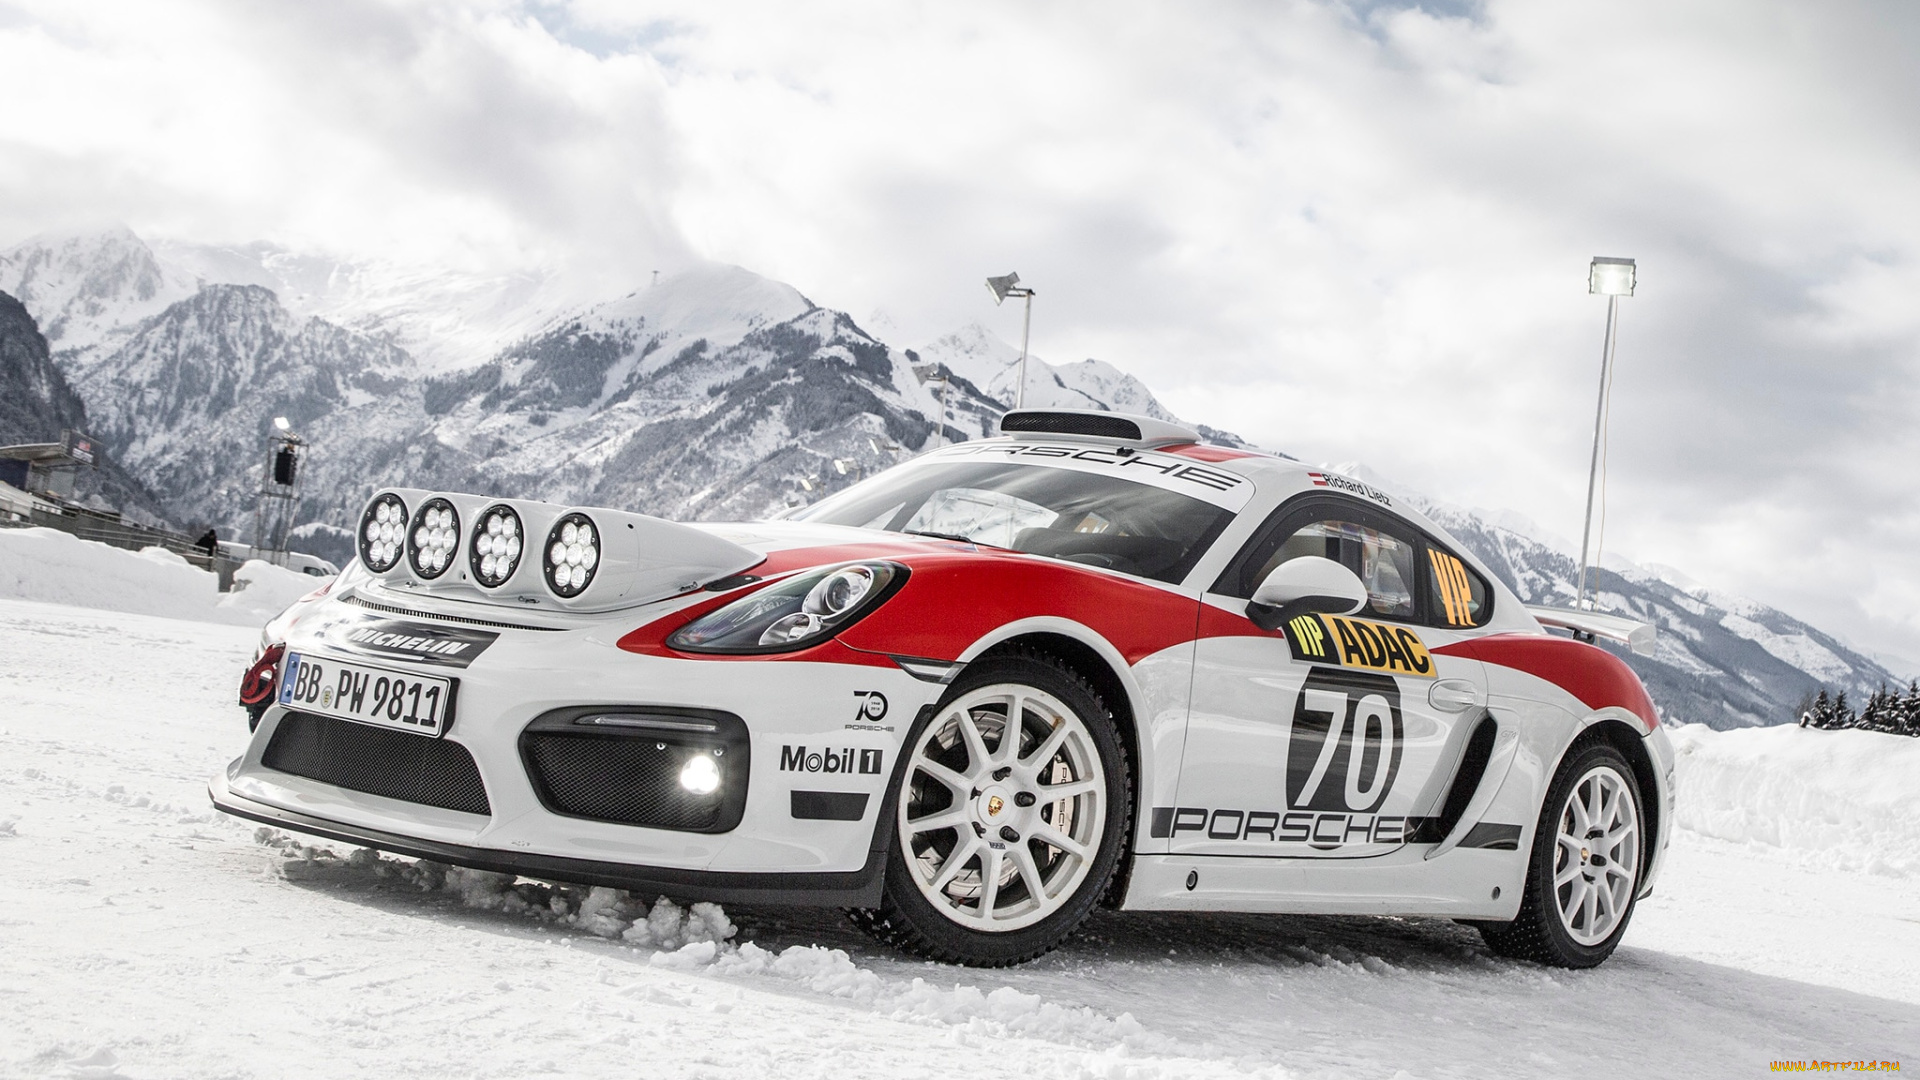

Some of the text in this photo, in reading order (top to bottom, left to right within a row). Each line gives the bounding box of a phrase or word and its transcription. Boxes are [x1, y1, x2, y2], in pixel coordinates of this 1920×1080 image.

[938, 446, 1242, 491] ORSCHE
[1322, 473, 1392, 507] Richard Lietz
[1427, 548, 1478, 626] VIP
[348, 628, 471, 655] MICHELIN
[1289, 615, 1429, 674] VIP ADAC
[294, 662, 322, 703] BB
[334, 669, 369, 713] PW
[371, 676, 440, 728] 9811
[853, 690, 889, 722] 70
[844, 724, 895, 732] PORSCHE
[780, 745, 855, 774] Mobil
[1294, 688, 1394, 811] 70
[1171, 807, 1405, 844] PORSCHE
